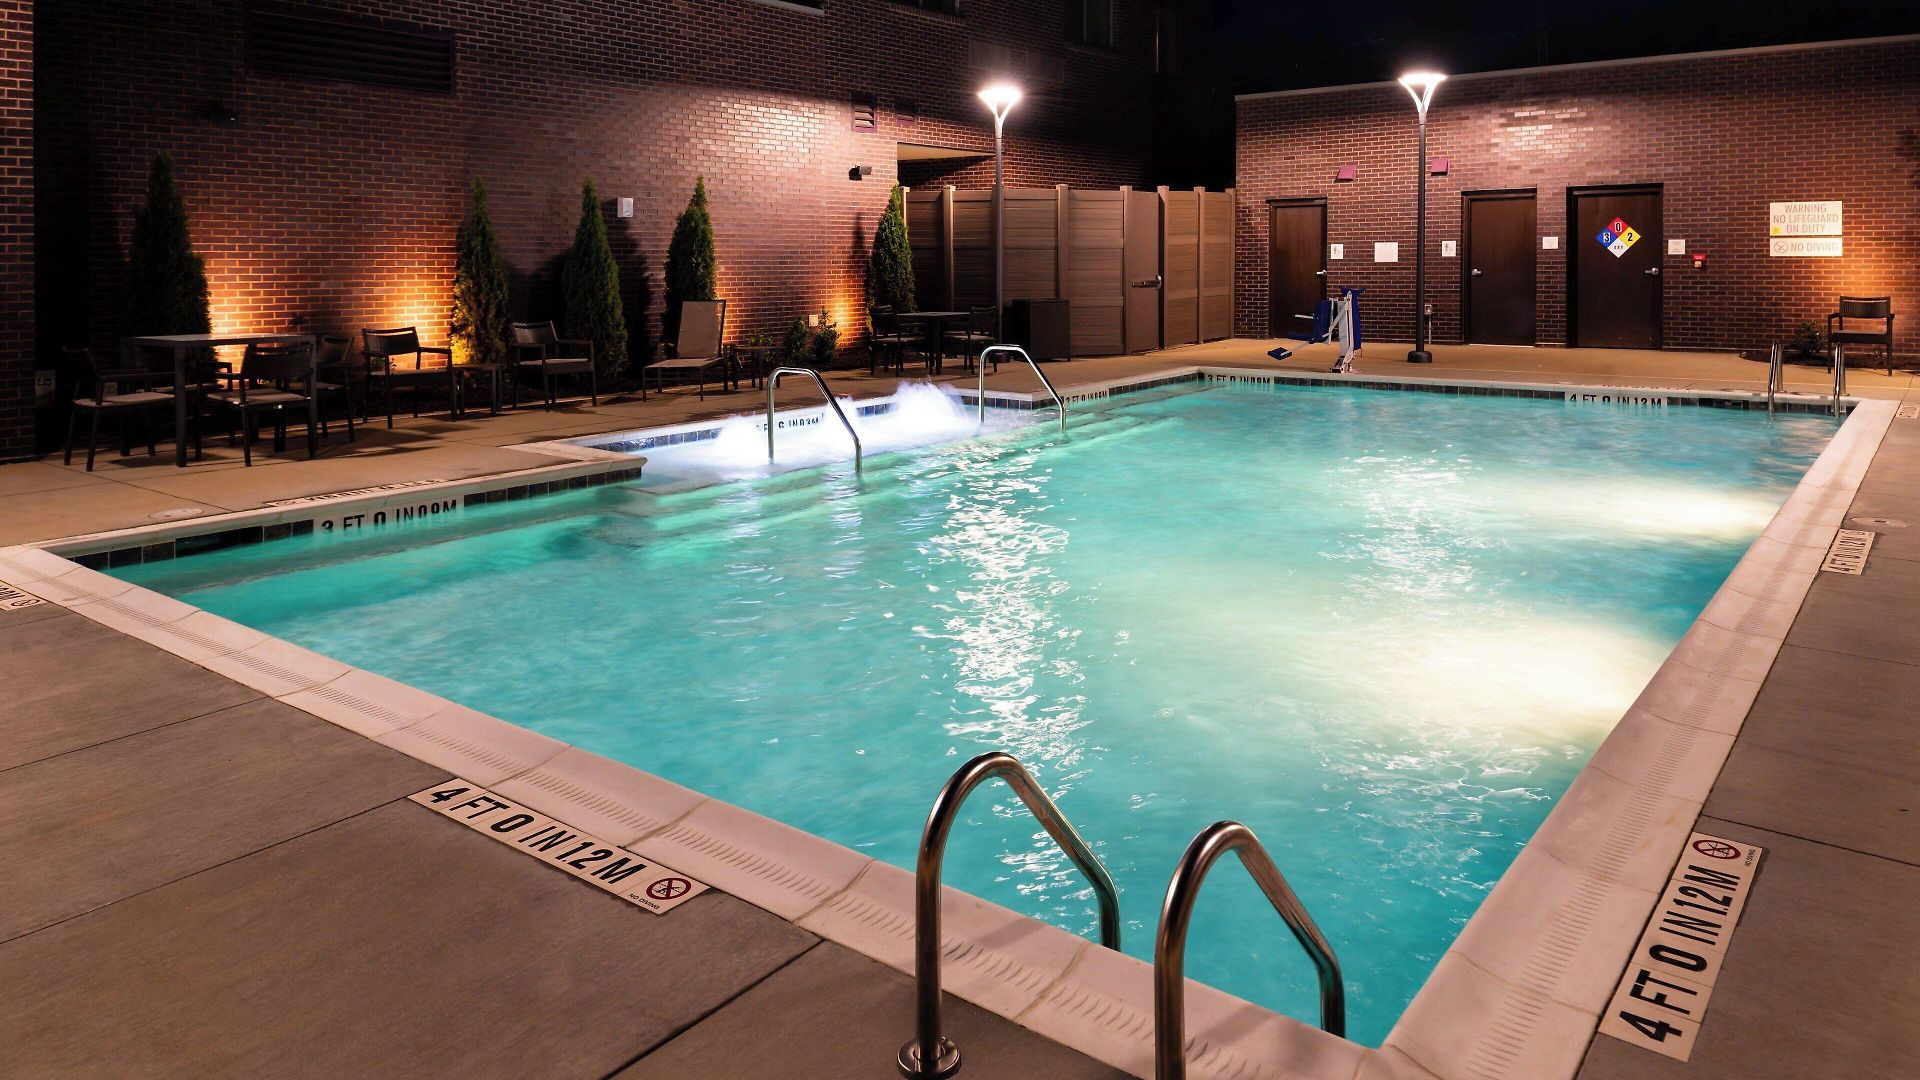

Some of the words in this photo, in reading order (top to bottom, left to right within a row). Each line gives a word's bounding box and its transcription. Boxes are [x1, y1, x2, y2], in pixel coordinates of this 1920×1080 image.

[1784, 203, 1827, 214] WARNING
[1615, 222, 1621, 232] 0
[1773, 215, 1786, 224] NO
[1789, 213, 1839, 223] LIFEGUARD
[1604, 233, 1610, 242] 3
[1627, 232, 1633, 242] 2
[1786, 224, 1799, 234] ON
[1802, 223, 1826, 233] DUTY
[1791, 243, 1804, 252] NO
[1807, 242, 1838, 252] DIVING
[343, 513, 365, 531] FT
[430, 786, 471, 804] 4
[448, 795, 511, 820] FT
[517, 825, 578, 853] IN
[1659, 910, 1722, 946] IN
[1629, 968, 1698, 1016] FT
[1618, 1009, 1683, 1043] 4
